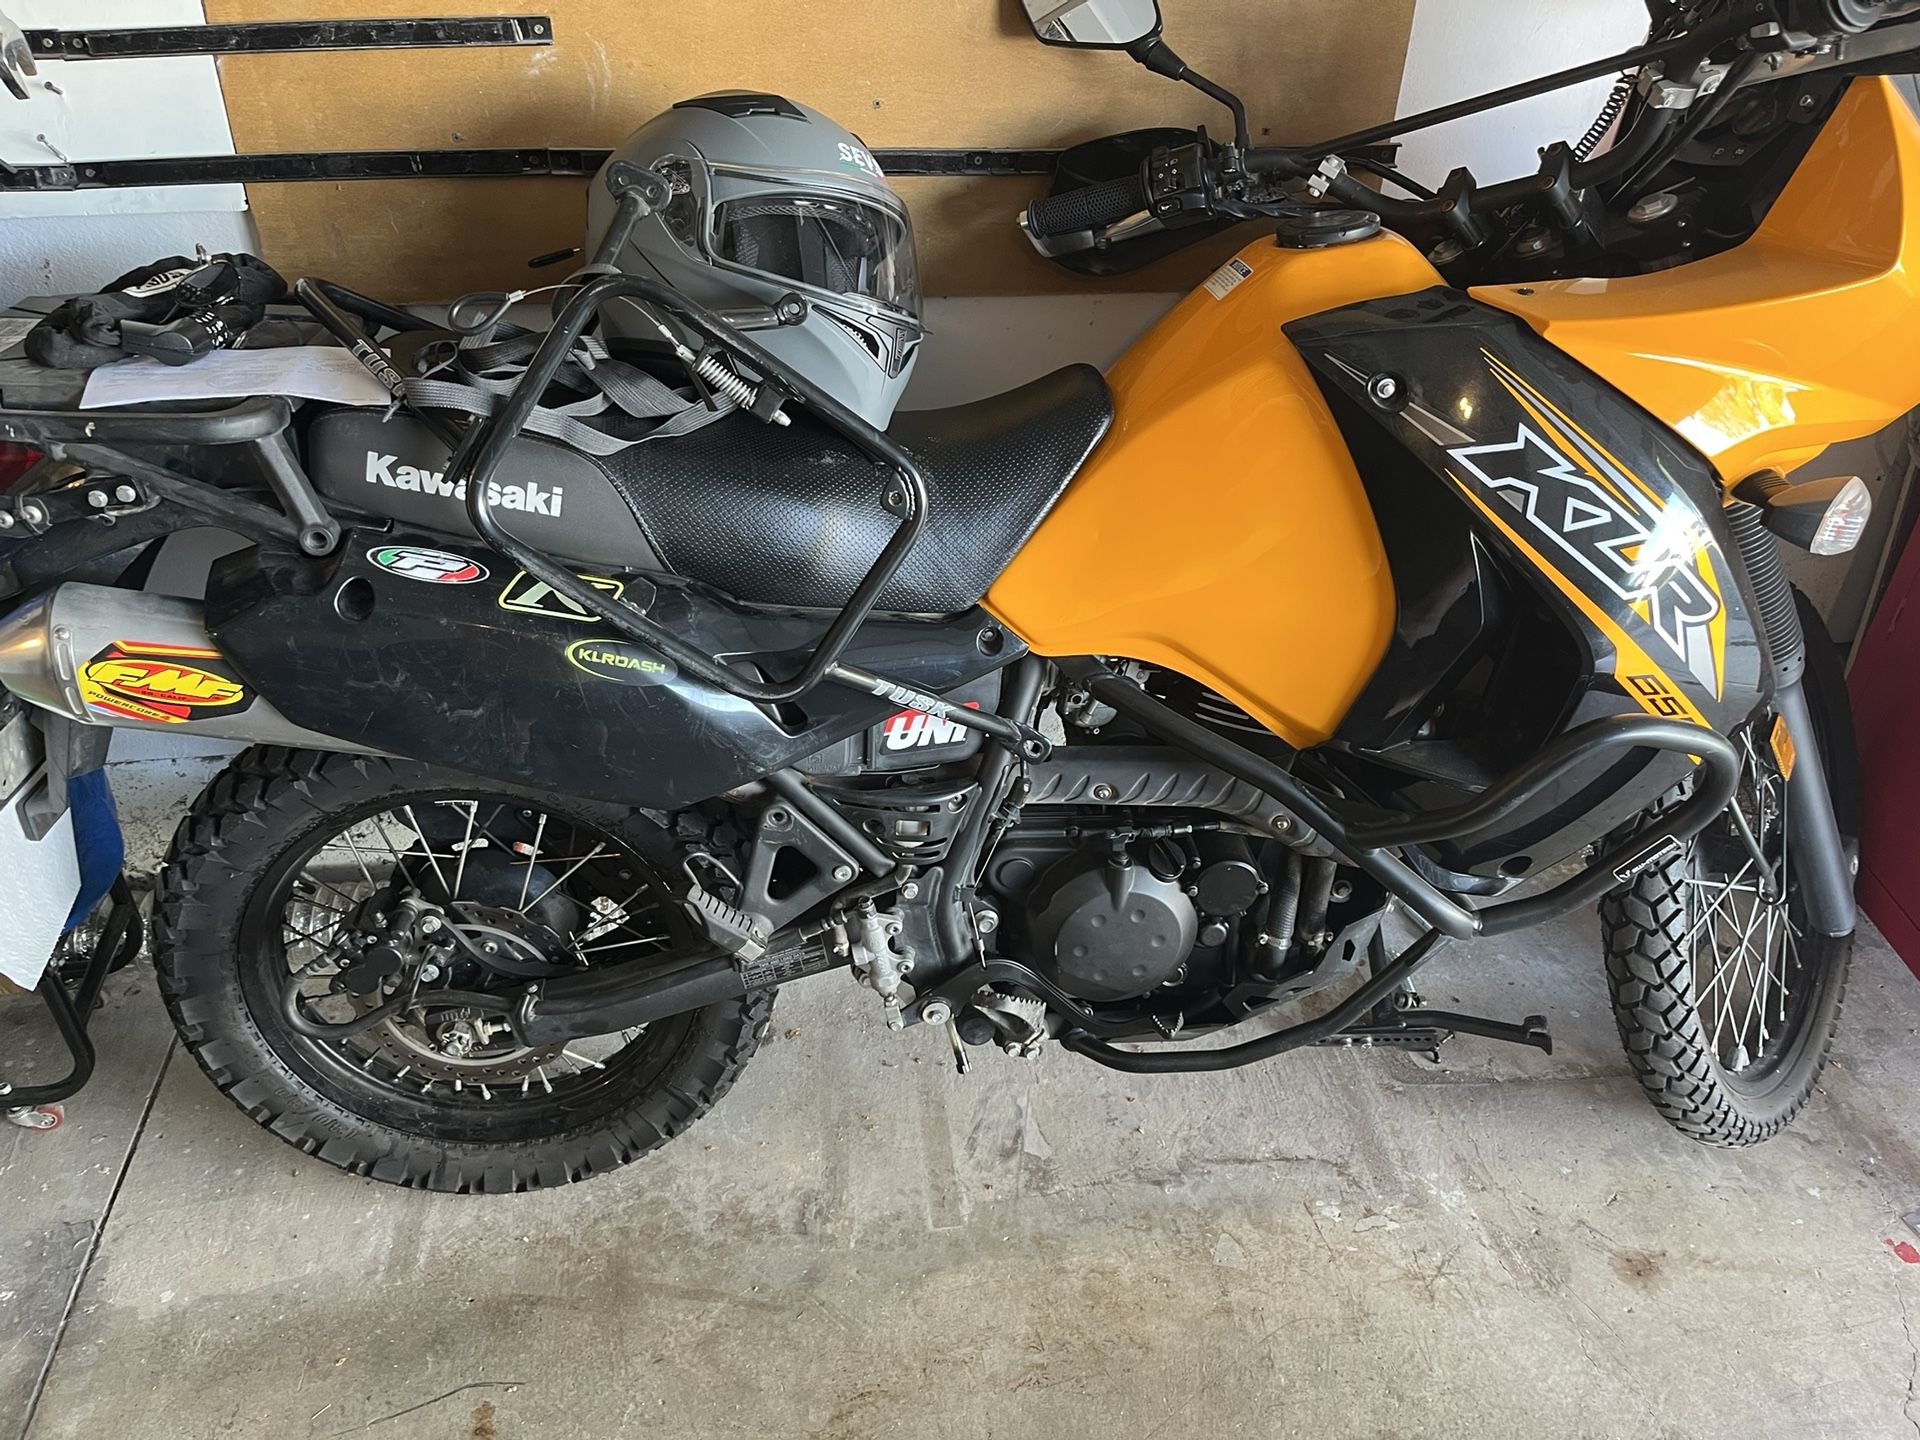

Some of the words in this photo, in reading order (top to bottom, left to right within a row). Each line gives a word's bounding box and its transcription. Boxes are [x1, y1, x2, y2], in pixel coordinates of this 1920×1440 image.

[1446, 422, 1719, 663] KLR
[578, 648, 665, 674] KLRDASH
[88, 663, 244, 699] FMF
[872, 678, 957, 720] TUSK
[1626, 674, 1696, 723] 65
[883, 714, 968, 751] UNI
